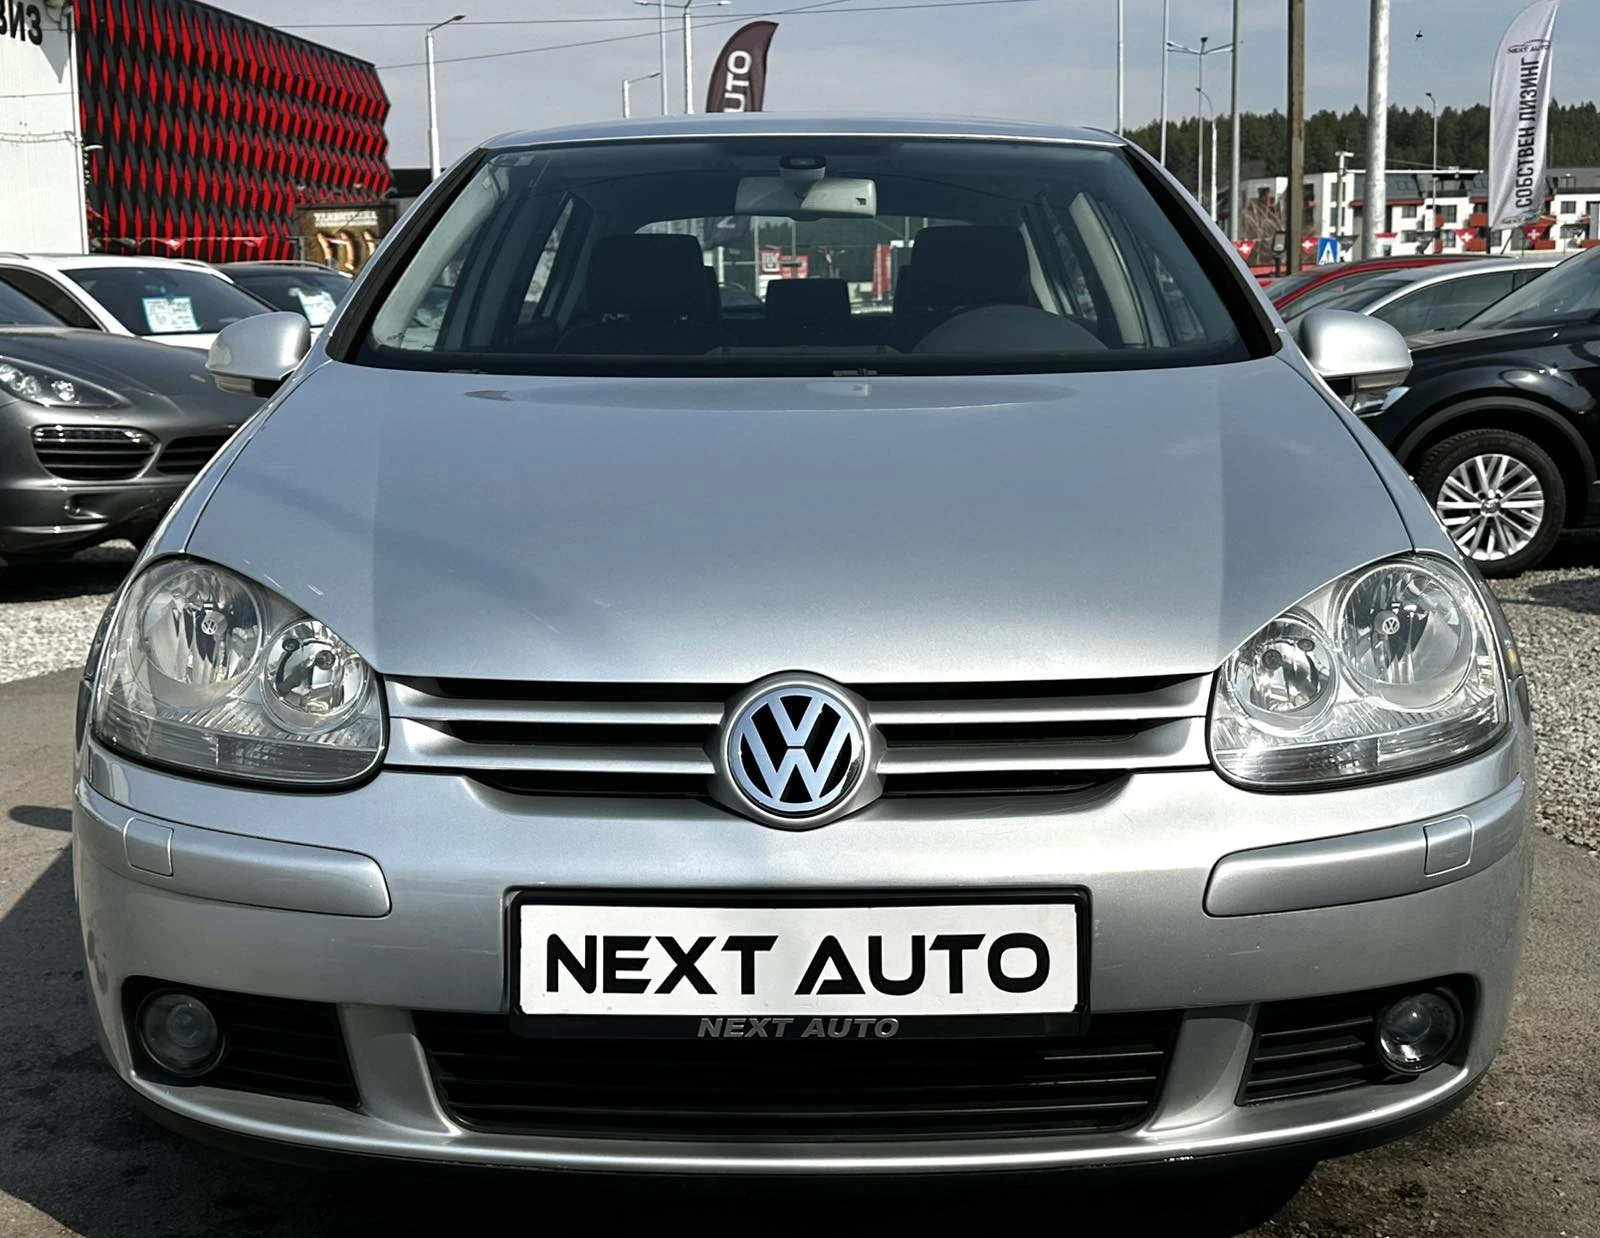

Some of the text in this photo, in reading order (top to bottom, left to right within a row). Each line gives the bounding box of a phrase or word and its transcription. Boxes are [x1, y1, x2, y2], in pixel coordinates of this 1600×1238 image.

[1519, 57, 1540, 121] ЛИЗИНГ
[1515, 126, 1536, 208] СОБСТВЕН
[732, 689, 860, 810] VW
[546, 932, 1051, 996] NEXT AUTO
[697, 1017, 900, 1038] NEXT AUTO
